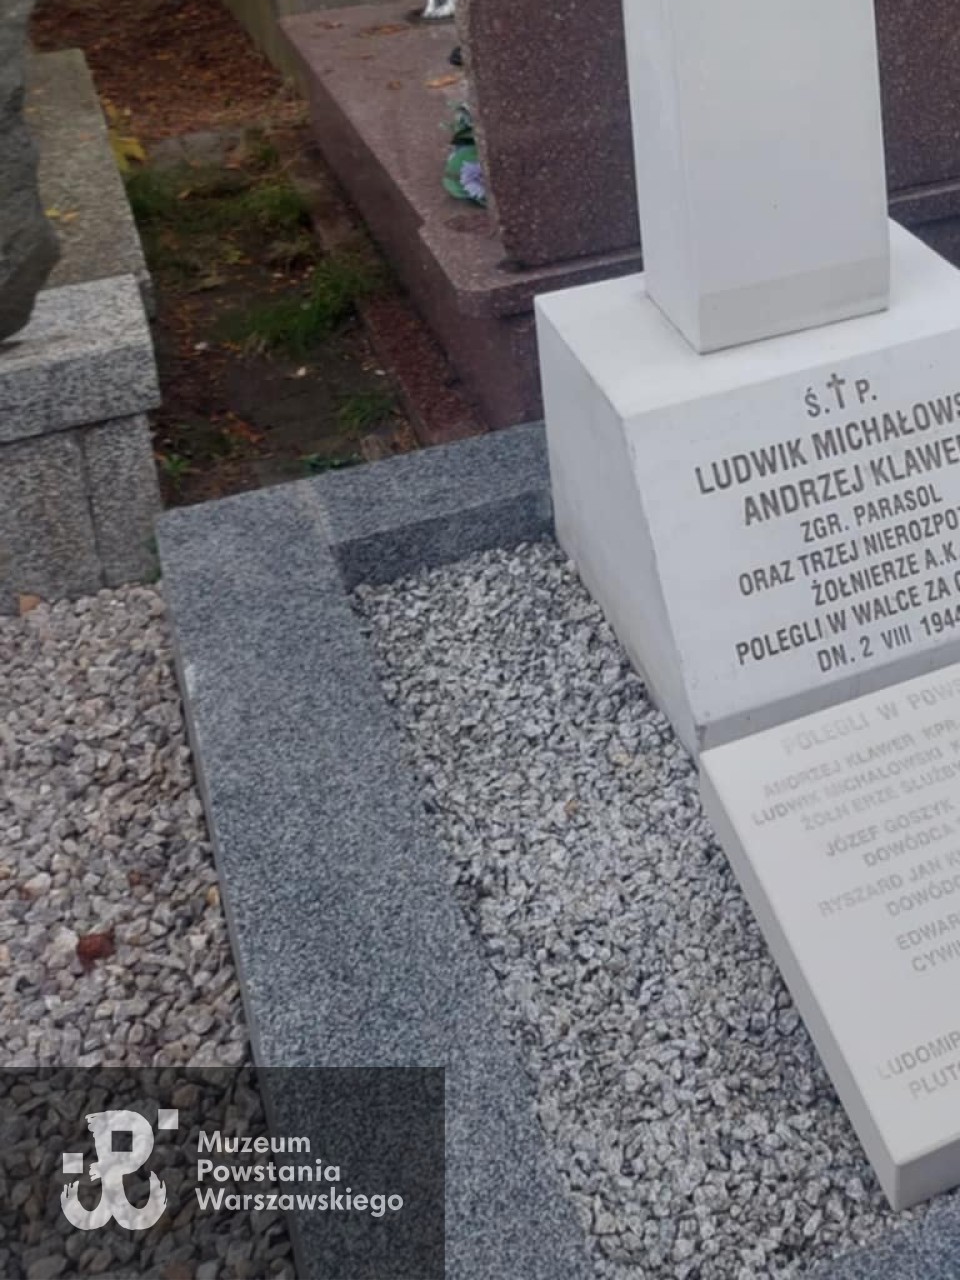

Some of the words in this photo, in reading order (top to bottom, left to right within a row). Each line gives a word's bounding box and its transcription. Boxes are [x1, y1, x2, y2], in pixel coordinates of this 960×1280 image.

[692, 436, 808, 495] LUDWIK
[738, 463, 866, 527] ANDRZEJ
[798, 509, 850, 544] ZGR.
[851, 481, 944, 527] PARASOL
[736, 558, 796, 597] ORAZ
[796, 537, 861, 577] TRZEJ
[808, 552, 921, 607] ŻOŁNIERZE
[734, 616, 824, 667] POLEGLI
[826, 608, 850, 635] W
[850, 584, 922, 627] WALCE
[922, 575, 950, 603] ZA
[815, 639, 856, 673] DN.
[857, 633, 875, 658] 2
[879, 621, 913, 652] VIII
[872, 698, 903, 723] W
[841, 730, 919, 770] KLAWER
[794, 781, 899, 834] ŻOŁNERZE
[818, 819, 884, 858] JÓZEF
[857, 815, 959, 869] DOWÓDCA
[814, 870, 906, 918] RYSZARD
[902, 855, 944, 883] JAN
